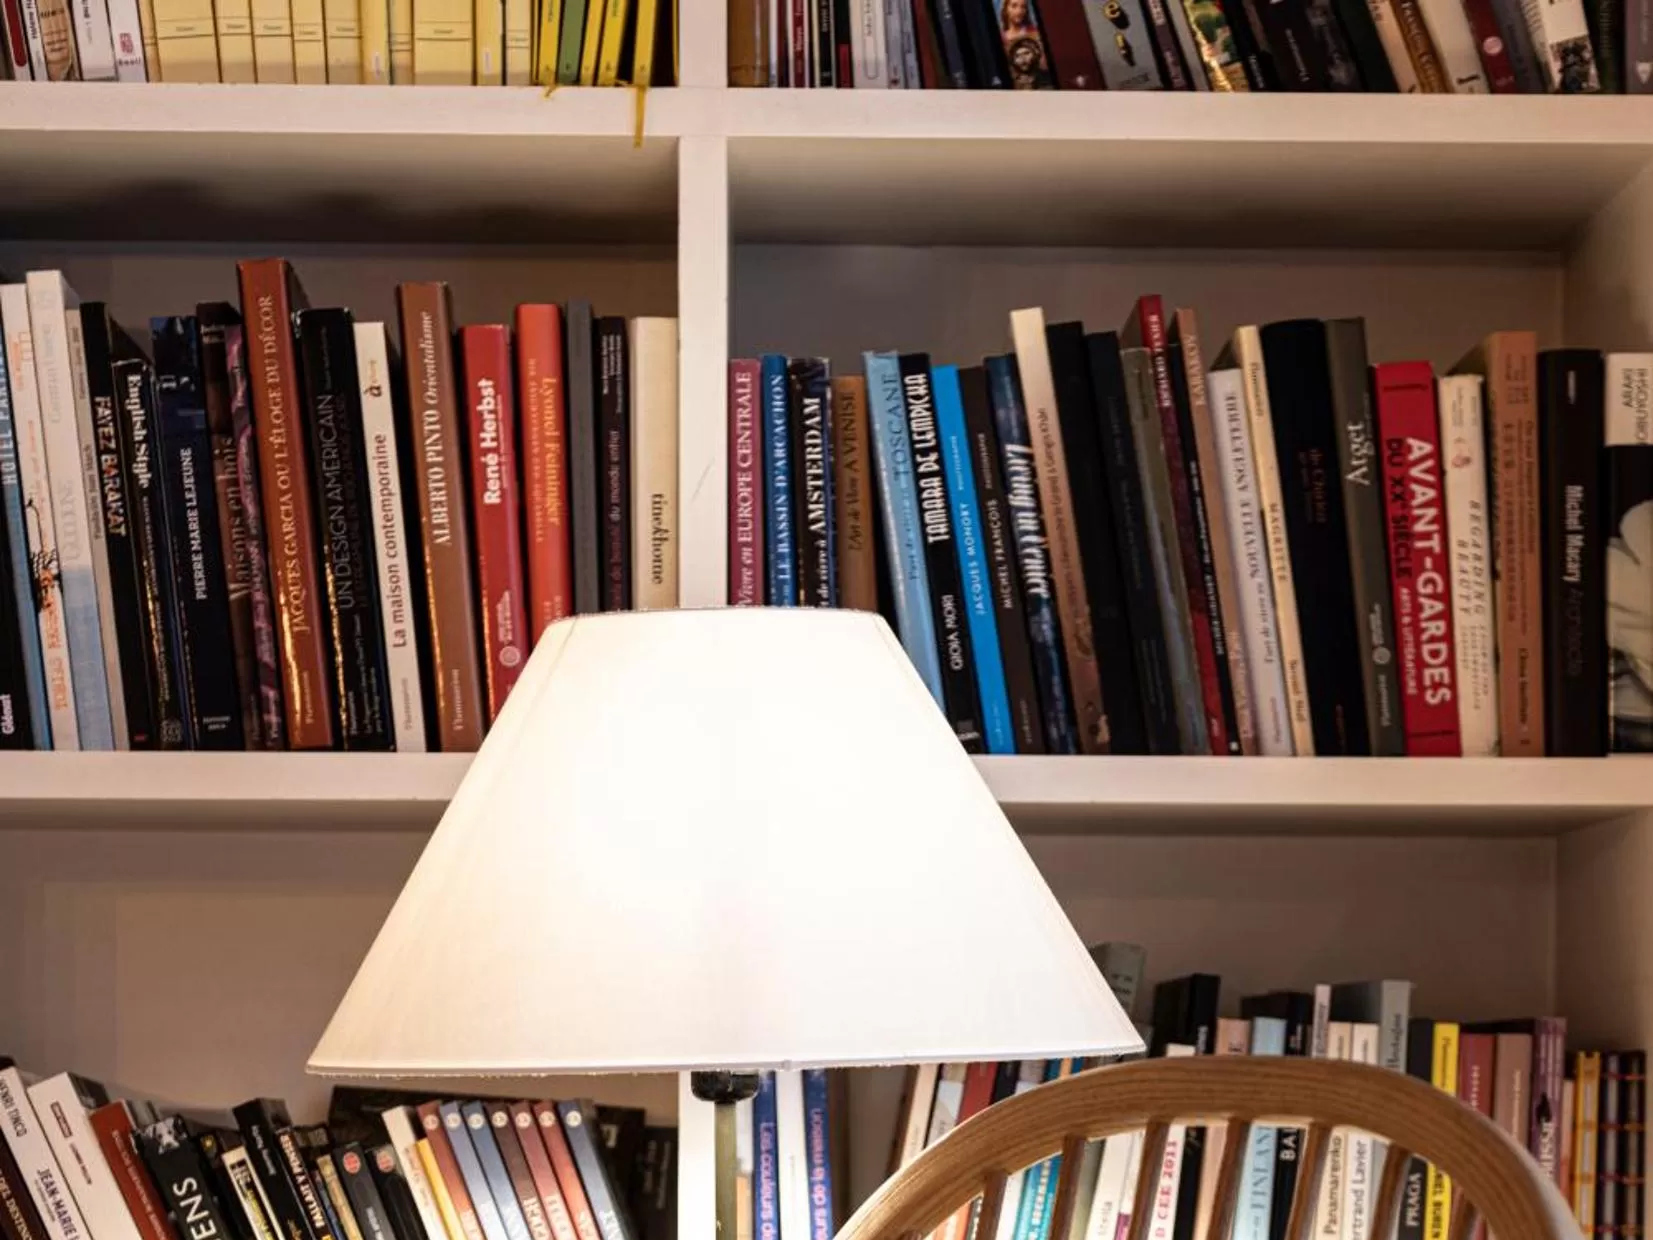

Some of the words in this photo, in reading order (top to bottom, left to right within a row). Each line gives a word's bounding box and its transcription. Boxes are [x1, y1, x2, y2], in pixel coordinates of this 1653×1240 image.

[254, 293, 279, 354] DÉCOR
[264, 357, 281, 382] DU
[416, 310, 439, 404] Orientalisme
[93, 395, 115, 451] FAYEZ
[123, 375, 146, 441] English
[265, 387, 288, 458] L'ÉLOGE
[422, 408, 443, 461] PINTO
[476, 377, 497, 448] Herbst
[539, 378, 558, 437] Lyonel
[735, 371, 751, 467] CENTRALE
[769, 373, 787, 486] D'ARCACHON
[840, 391, 857, 454] VENISE
[881, 369, 910, 481] TOSCANE
[131, 442, 151, 488] Style
[317, 393, 343, 501] AMERICAIN
[801, 396, 828, 534] AMSTERDAM
[916, 450, 939, 472] DE
[1223, 391, 1250, 493] ANGLETERRE
[1340, 420, 1371, 486] Atget
[1384, 437, 1404, 468] DU
[100, 453, 126, 537] BARAKAT
[179, 446, 197, 506] LEJEUNE
[224, 485, 242, 509] en
[275, 460, 291, 489] OU
[371, 433, 399, 559] contemporaine
[480, 453, 501, 504] René
[541, 443, 562, 526] Feininger
[608, 464, 620, 502] monde
[186, 508, 201, 550] MARIE
[278, 492, 299, 555] GARCIA
[427, 466, 451, 546] ALBERTO
[609, 505, 620, 520] du
[736, 471, 752, 541] EUROPE
[774, 493, 789, 551] BASSIN
[919, 475, 951, 542] TAMARA
[957, 501, 977, 556] MONORY
[985, 497, 1008, 561] FRANÇOIS
[1565, 485, 1582, 530] Michel
[223, 516, 251, 599] Maisons
[328, 504, 350, 577] DESIGN
[740, 546, 752, 563] en
[778, 557, 790, 578] LE
[1238, 498, 1262, 579] NOUVELLE
[1268, 502, 1288, 582] MAGRITTE
[1391, 514, 1413, 579] SIÈCLE
[1467, 500, 1487, 616] REGARDING
[1562, 534, 1583, 583] Macary
[191, 553, 207, 600] PIERRE
[285, 557, 310, 632] JACQUES
[335, 579, 354, 608] UN
[384, 563, 404, 623] maison
[738, 567, 752, 605] Vivre
[967, 559, 987, 614] JACQUES
[995, 564, 1014, 609] MICHEL
[1400, 435, 1457, 706] AVANT-GARDES
[1455, 540, 1473, 615] BEAUTY
[390, 628, 406, 647] La
[940, 593, 957, 627] MORI
[946, 630, 964, 670] GIOIA
[278, 1131, 305, 1174] PENSER
[760, 1123, 774, 1149] Les
[809, 1108, 823, 1162] maison
[1161, 1137, 1178, 1179] 2011
[1351, 1139, 1368, 1185] Lavier
[37, 1166, 78, 1236] JEAN-MARIE
[294, 1171, 308, 1183] Y
[760, 1154, 775, 1218] couleurs
[811, 1167, 824, 1180] la
[812, 1184, 825, 1204] de
[1156, 1184, 1172, 1221] CEE
[1322, 1135, 1344, 1234] Panamarenko
[1405, 1171, 1421, 1225] PRAGA
[298, 1181, 326, 1227] FALLAIT
